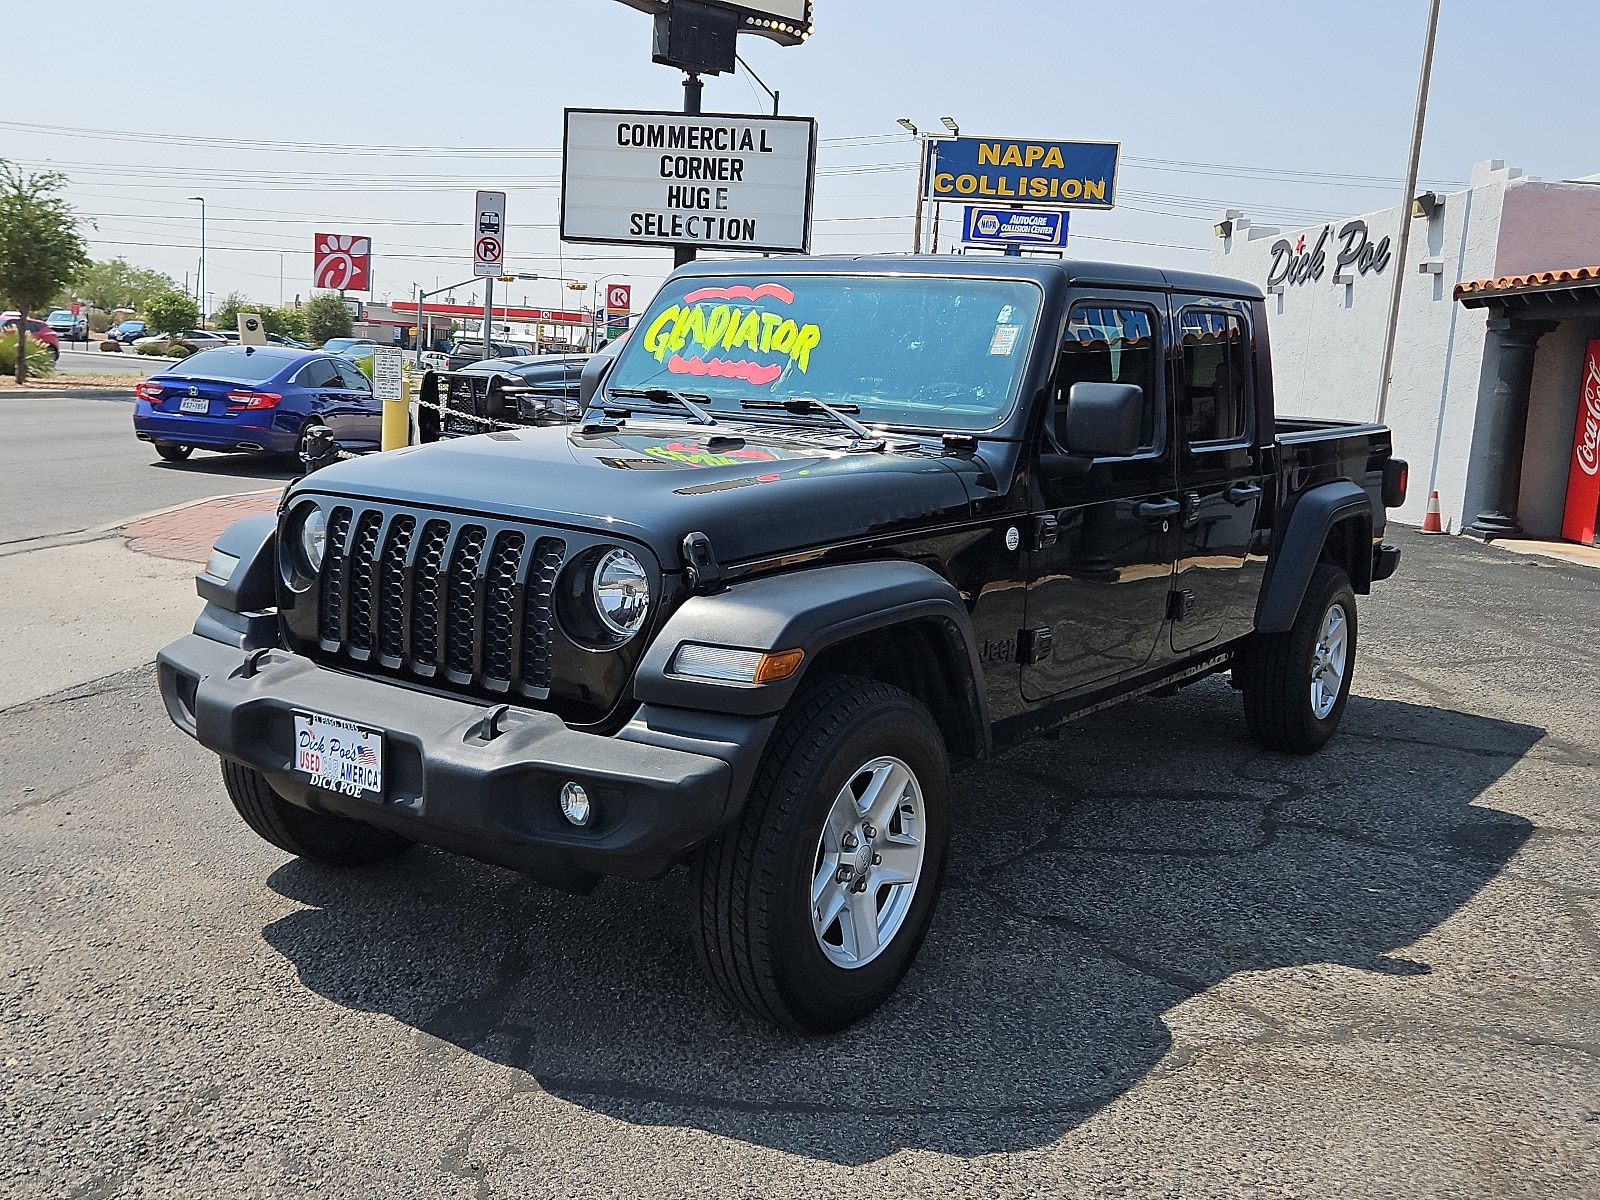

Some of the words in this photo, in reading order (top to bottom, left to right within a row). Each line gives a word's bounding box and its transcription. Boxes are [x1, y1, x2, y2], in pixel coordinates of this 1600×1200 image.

[617, 123, 773, 153] COMMERCIAL
[660, 155, 744, 181] CORNER
[977, 143, 1065, 168] NAPA
[667, 185, 728, 210] HUGE
[934, 173, 1106, 200] COLLISION
[630, 213, 756, 241] SELECTION
[981, 220, 997, 230] NAPA
[1000, 223, 1031, 233] COLLISION
[1030, 225, 1054, 234] CENTER
[1267, 223, 1330, 286] Dick
[1334, 219, 1391, 279] Poe
[643, 304, 821, 374] GLADIATOR
[1577, 353, 1600, 475] Coca-Col
[299, 730, 325, 754] Dick
[329, 738, 358, 761] Poe's
[299, 750, 321, 773] USED
[340, 761, 379, 789] AMERICA
[309, 773, 338, 792] DICK
[338, 780, 364, 799] POE
